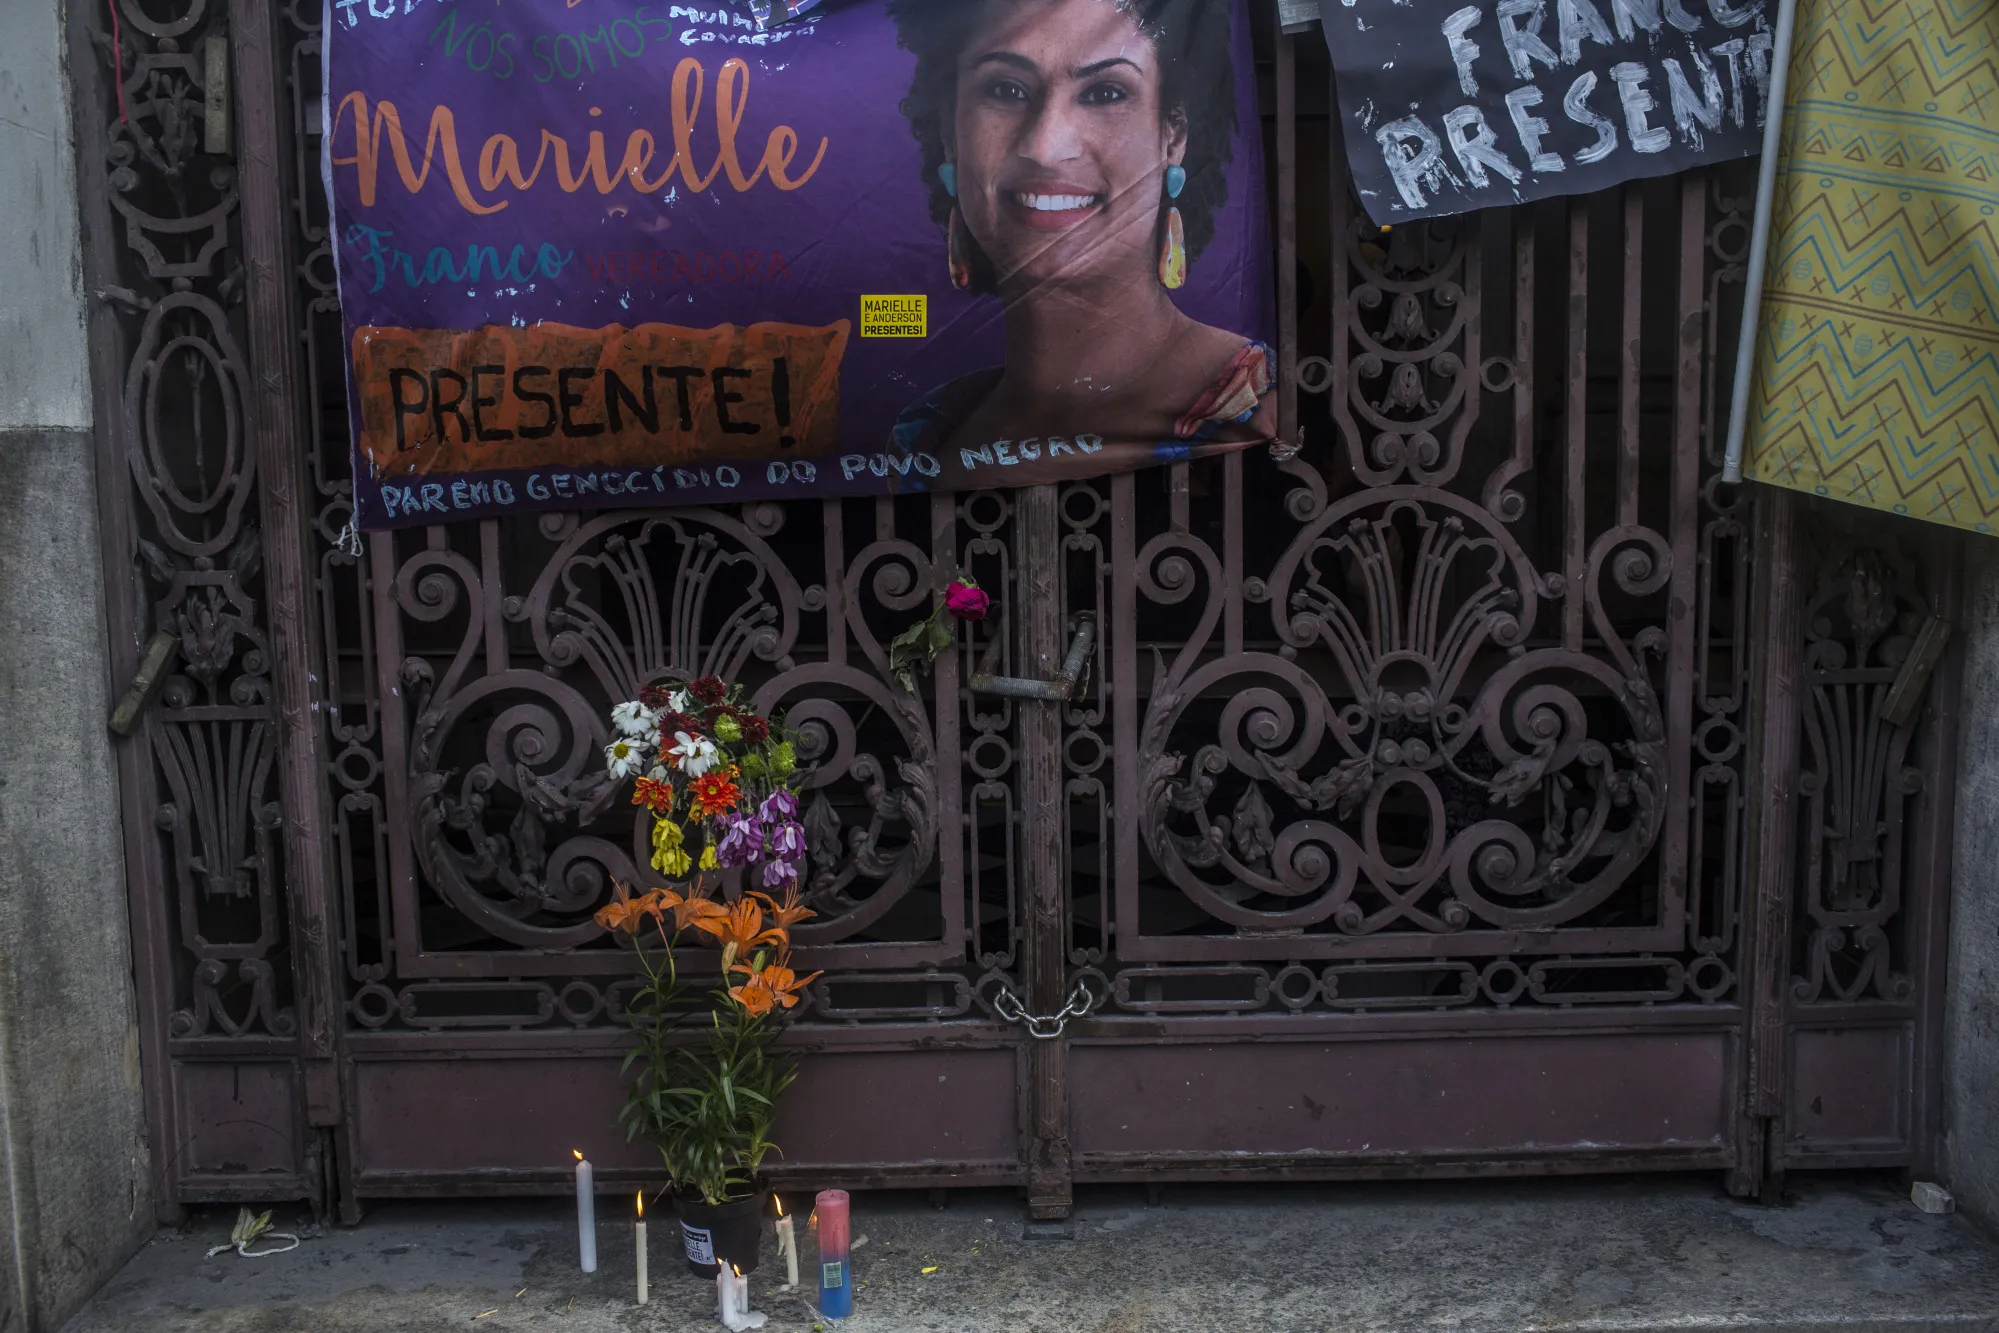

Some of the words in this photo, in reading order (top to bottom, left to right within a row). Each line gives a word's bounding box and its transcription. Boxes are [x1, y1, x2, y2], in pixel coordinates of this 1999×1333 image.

[429, 7, 515, 79] NÓS
[533, 6, 673, 82] SOMOS
[331, 57, 829, 214] Marielle
[346, 223, 574, 294] Franco
[586, 250, 789, 284] VEREADORA
[864, 300, 922, 312] MARIELLE
[864, 313, 870, 322] E
[872, 313, 922, 322] ANDERSON
[388, 356, 796, 452] PRESENTE!
[526, 464, 741, 500] GENOCÍDIO
[766, 460, 816, 484] DO
[959, 432, 1103, 470] NEGRO
